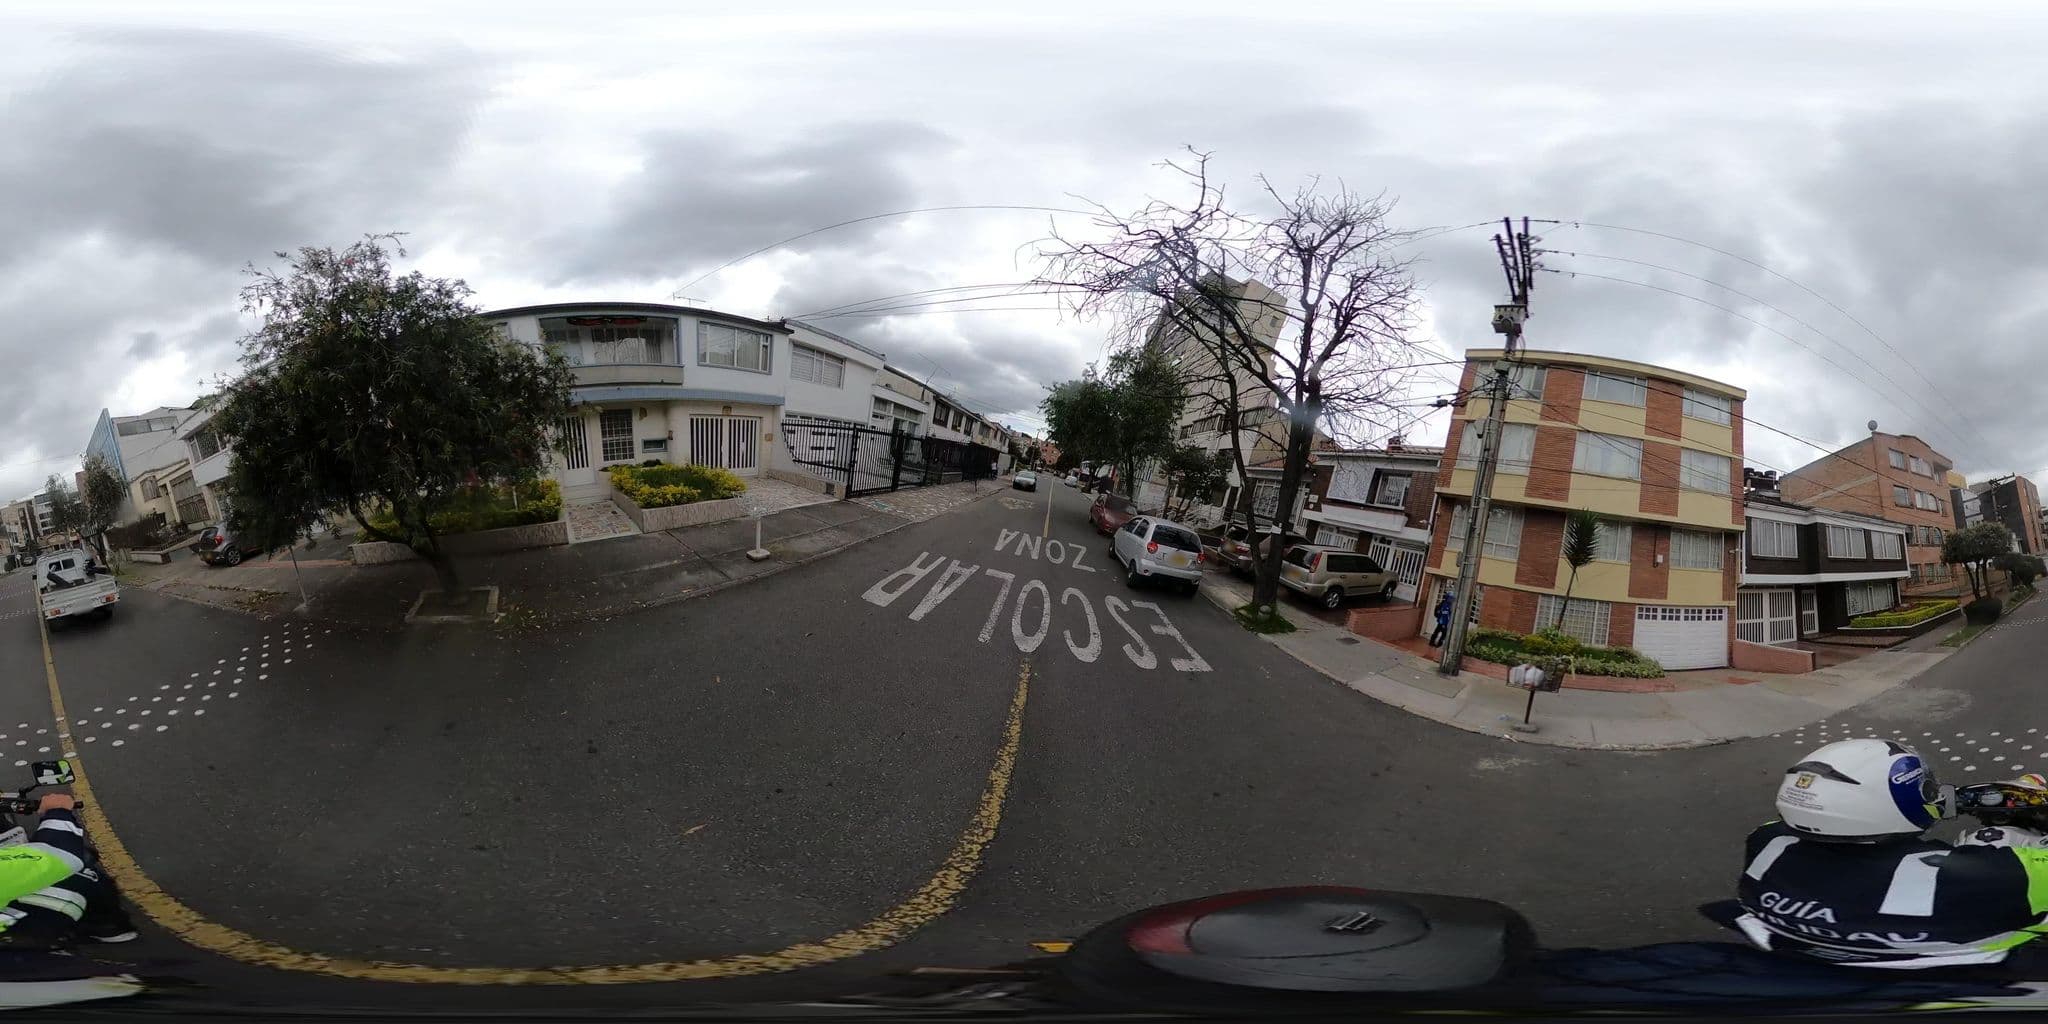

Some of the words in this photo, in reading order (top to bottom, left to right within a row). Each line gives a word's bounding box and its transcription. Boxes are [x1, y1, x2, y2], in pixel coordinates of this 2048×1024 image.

[994, 528, 1096, 572] ZONA
[861, 552, 1214, 672] ESCOLAR
[1760, 892, 1837, 923] GUÍA
